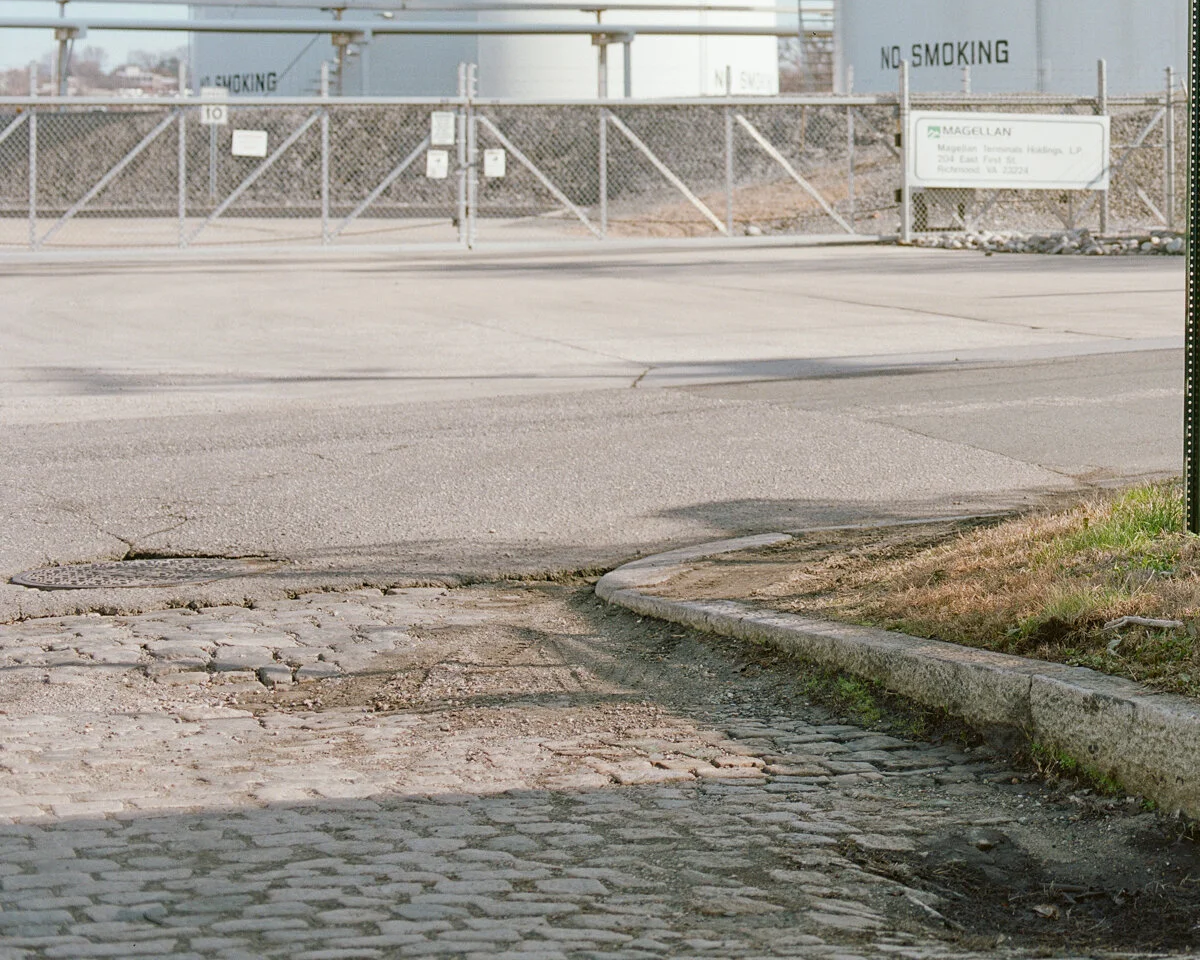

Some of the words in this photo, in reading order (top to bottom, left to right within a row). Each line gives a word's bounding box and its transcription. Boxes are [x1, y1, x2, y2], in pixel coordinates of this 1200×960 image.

[881, 46, 900, 69] NO
[912, 40, 1009, 67] SMOKING
[206, 106, 222, 120] 10
[942, 126, 1012, 137] MAGELLAN
[937, 143, 978, 154] Magellan
[959, 155, 978, 164] East
